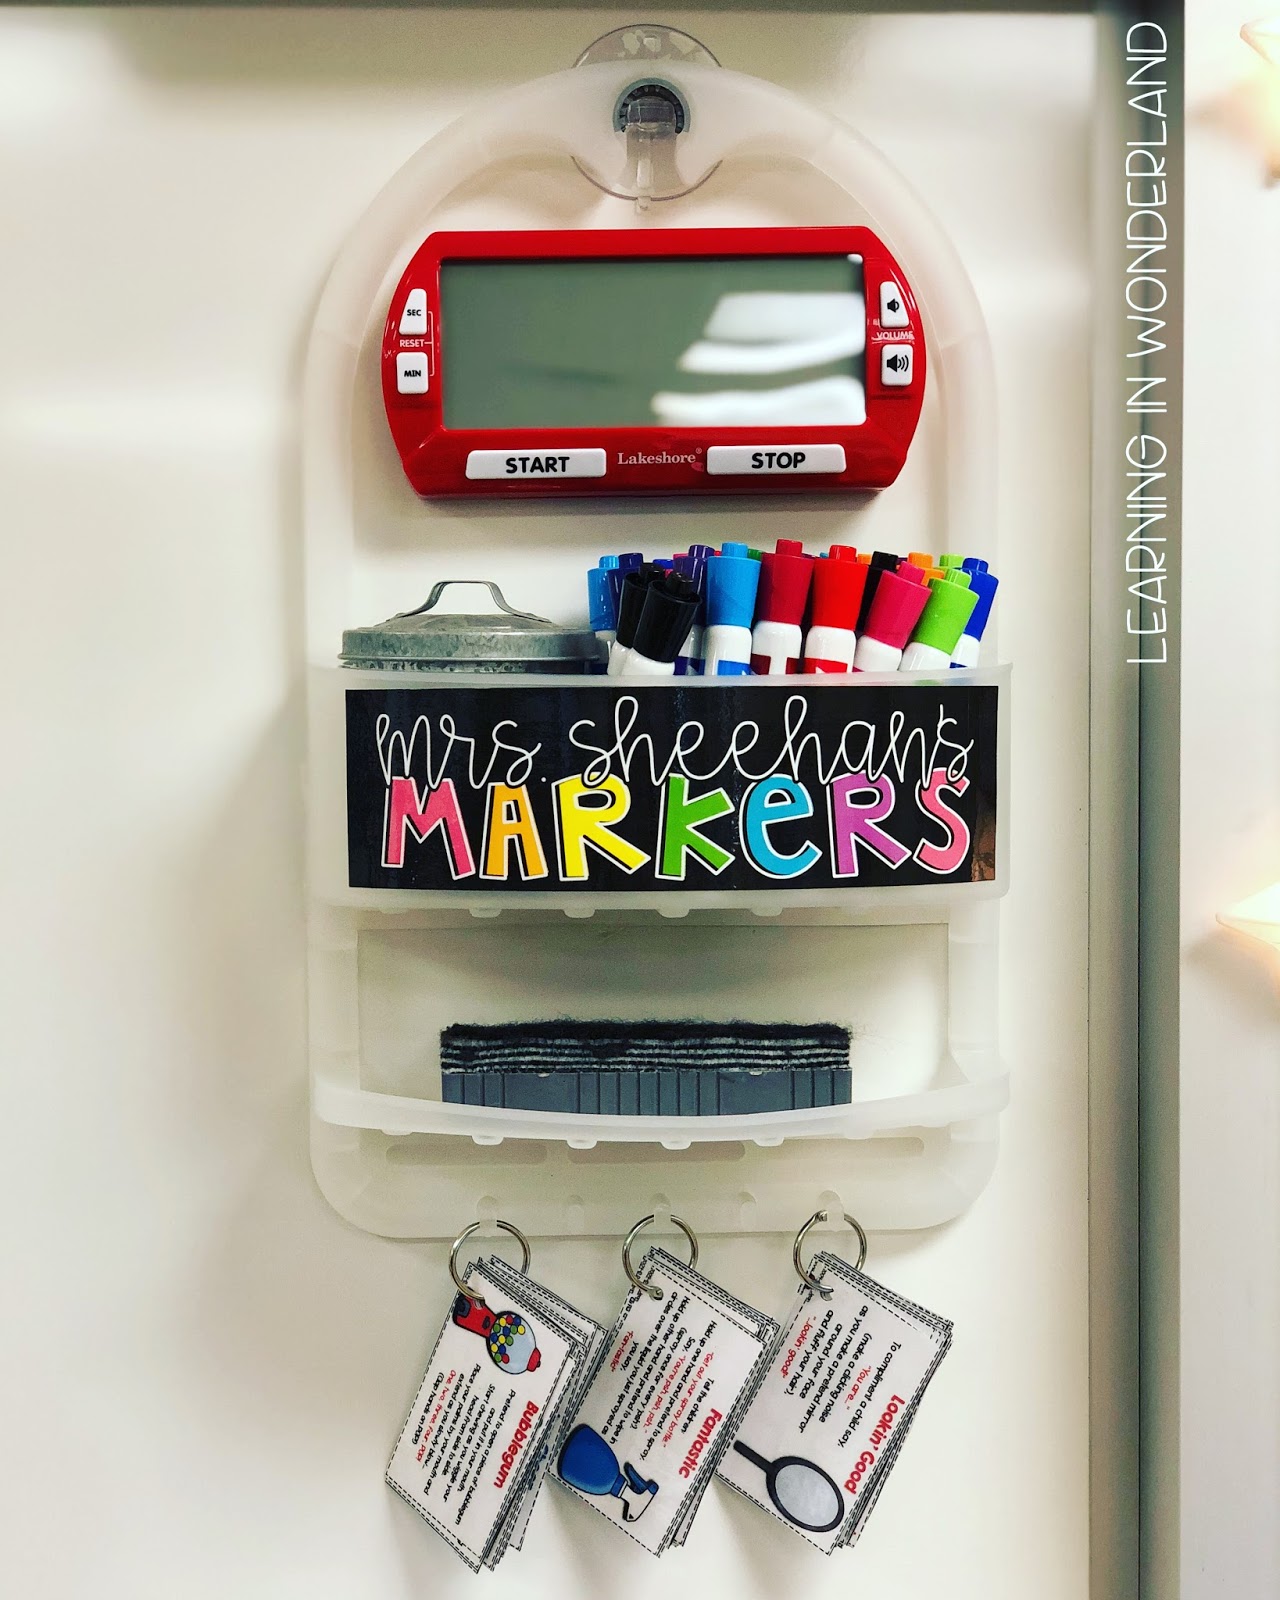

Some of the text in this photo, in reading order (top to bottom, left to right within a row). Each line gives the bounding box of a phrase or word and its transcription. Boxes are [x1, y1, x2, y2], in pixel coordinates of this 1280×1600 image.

[406, 308, 422, 317] SEC
[399, 339, 425, 348] RESET
[876, 330, 914, 341] VOLUME
[403, 368, 422, 378] MIN
[504, 455, 570, 475] START
[750, 451, 807, 470] STOP
[703, 1319, 718, 1339] Hold
[820, 1309, 834, 1330] and
[628, 1340, 639, 1357] you
[668, 1326, 688, 1354] (spray
[698, 1336, 708, 1348] up
[809, 1327, 826, 1352] fluff
[889, 1341, 902, 1352] To
[600, 1291, 678, 1436] circles over the liquid you just sprayed as
[659, 1352, 672, 1372] once
[690, 1347, 702, 1363] one
[798, 1322, 843, 1399] around your face
[798, 1349, 813, 1373] your
[608, 1295, 691, 1445] Hold up other hand and pretend to wipe in
[653, 1370, 664, 1386] for
[680, 1361, 696, 1384] hand
[695, 1365, 705, 1380] out
[798, 1304, 869, 1434] as you make a pretend mirror
[818, 1332, 873, 1423] (make a clicking noise
[855, 1365, 872, 1384] "You
[863, 1351, 893, 1402] compliment
[432, 1371, 445, 1391] (Clap
[450, 1372, 465, 1402] extend
[672, 1381, 684, 1400] and
[686, 1378, 698, 1398] your
[702, 1377, 715, 1392] Tell
[423, 1390, 437, 1415] hands
[446, 1399, 456, 1410] as
[466, 1394, 480, 1417] head
[640, 1384, 656, 1409] every
[696, 1389, 708, 1403] the
[859, 1400, 867, 1409] a
[440, 1408, 450, 1425] you
[483, 1407, 496, 1425] and
[656, 1395, 679, 1430] pretend
[672, 1397, 689, 1421] spray
[418, 1414, 426, 1425] on
[423, 1362, 482, 1496] Place your palms by your mouth and
[458, 1415, 471, 1436] from
[480, 1421, 492, 1438] put
[847, 1408, 863, 1431] child
[430, 1424, 444, 1448] slowly
[451, 1434, 462, 1451] side
[477, 1435, 485, 1444] it
[652, 1428, 661, 1437] to
[442, 1383, 496, 1503] Start chewing as you wiggle your
[474, 1441, 483, 1450] in
[492, 1400, 540, 1489] Bubblegum
[678, 1407, 723, 1479] Fantastic
[843, 1394, 906, 1495] Lookin' Good
[448, 1451, 456, 1461] to
[454, 1388, 517, 1526] Pretend to open a piece of bubblegum
[467, 1449, 478, 1469] your
